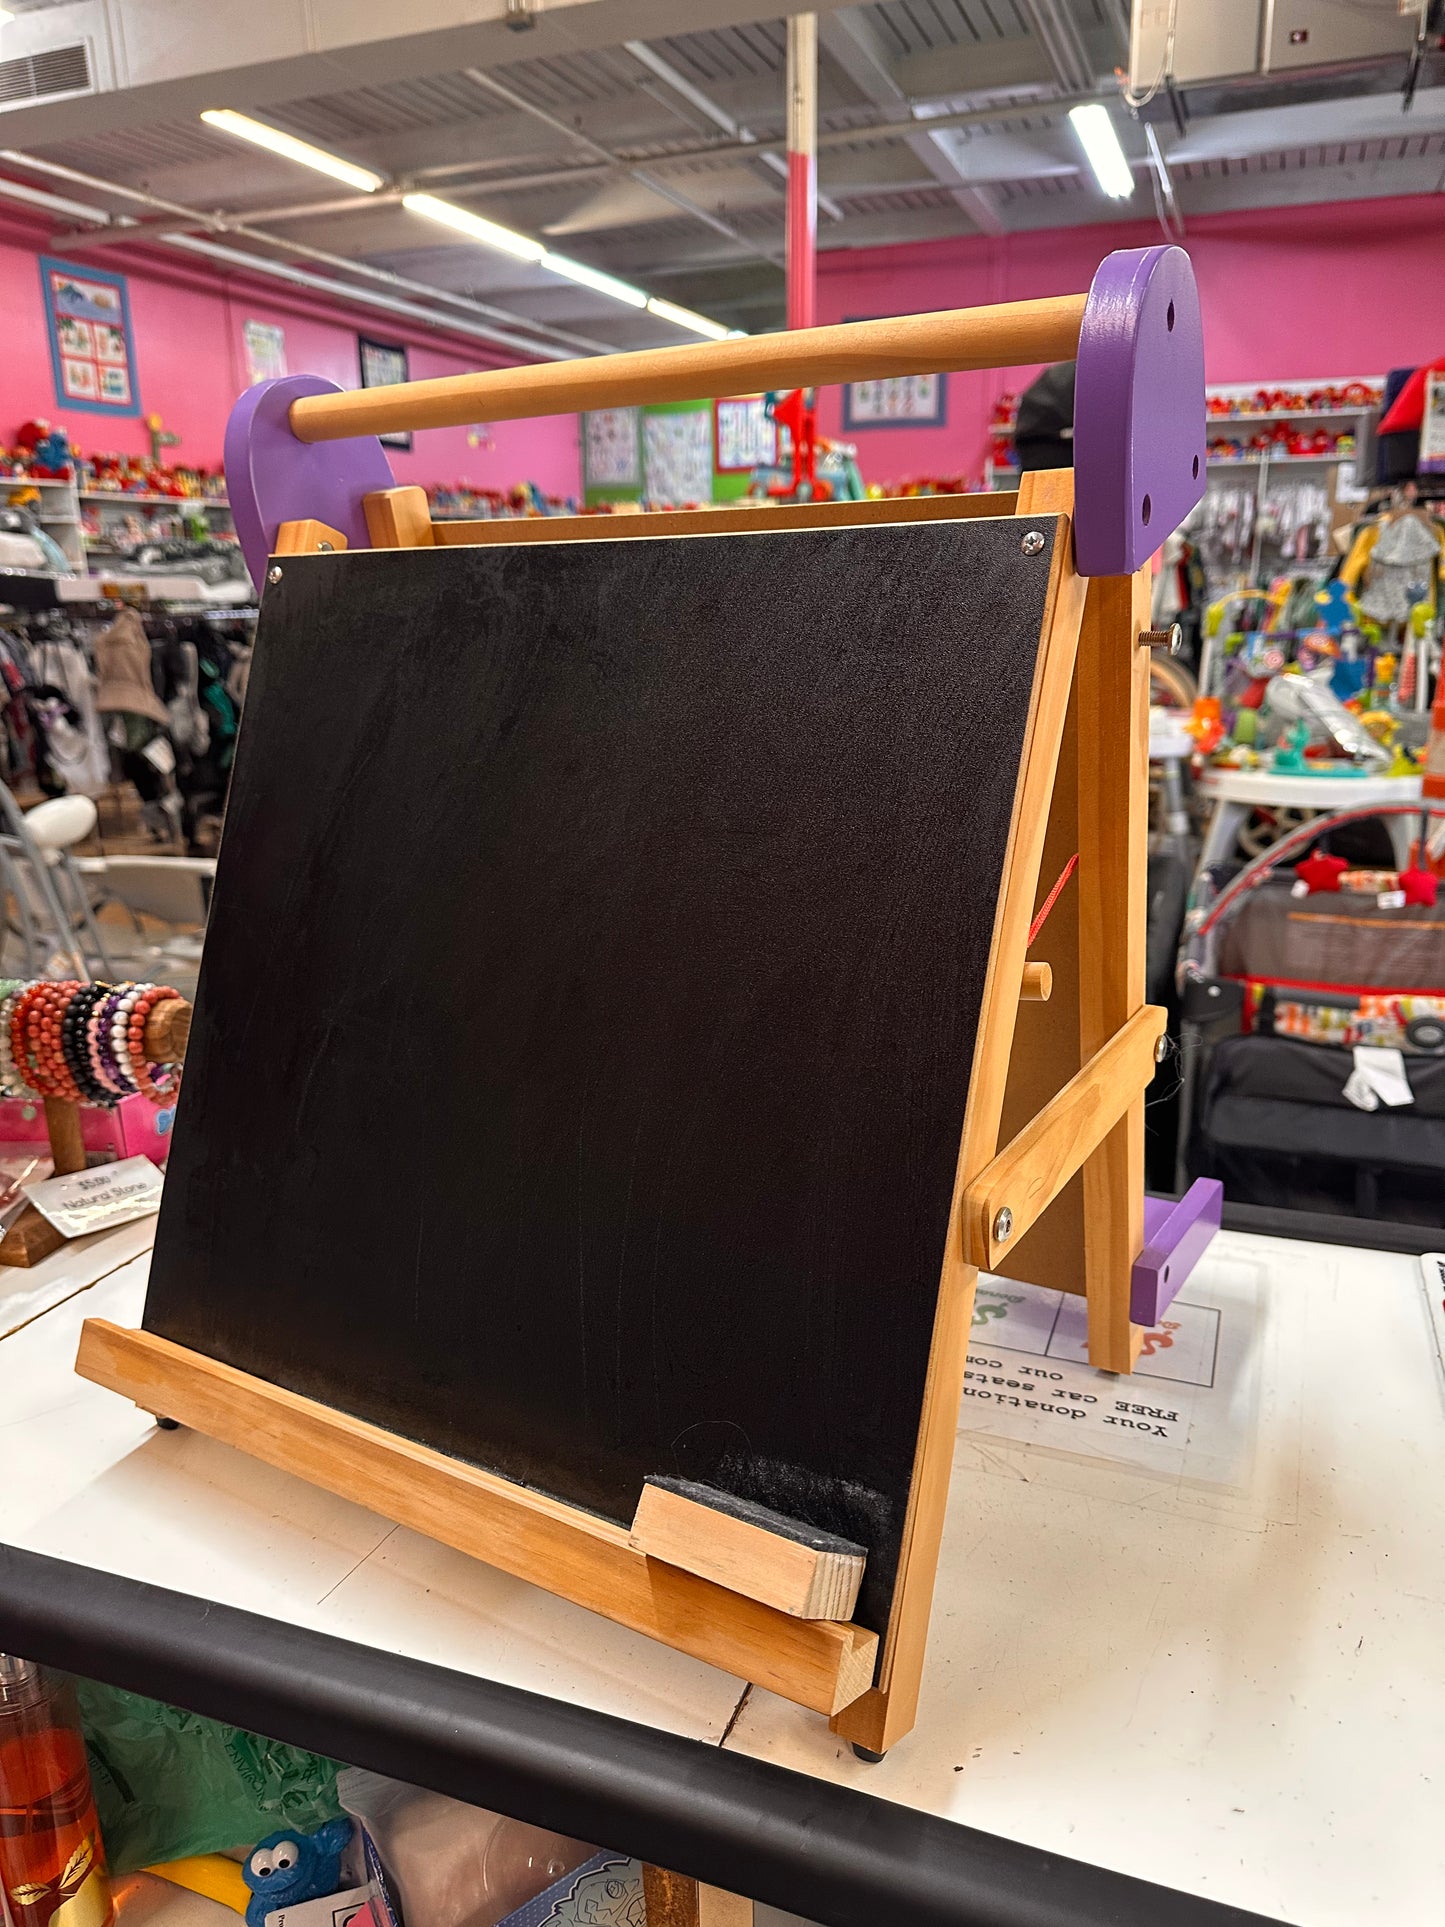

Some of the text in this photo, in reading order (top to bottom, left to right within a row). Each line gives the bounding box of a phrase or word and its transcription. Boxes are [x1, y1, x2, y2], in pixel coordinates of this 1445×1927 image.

[62, 1182, 147, 1209] Natural Stone
[1018, 1366, 1064, 1381] our
[962, 1387, 1168, 1437] Your donation
[963, 1371, 1179, 1422] FREE car seats
